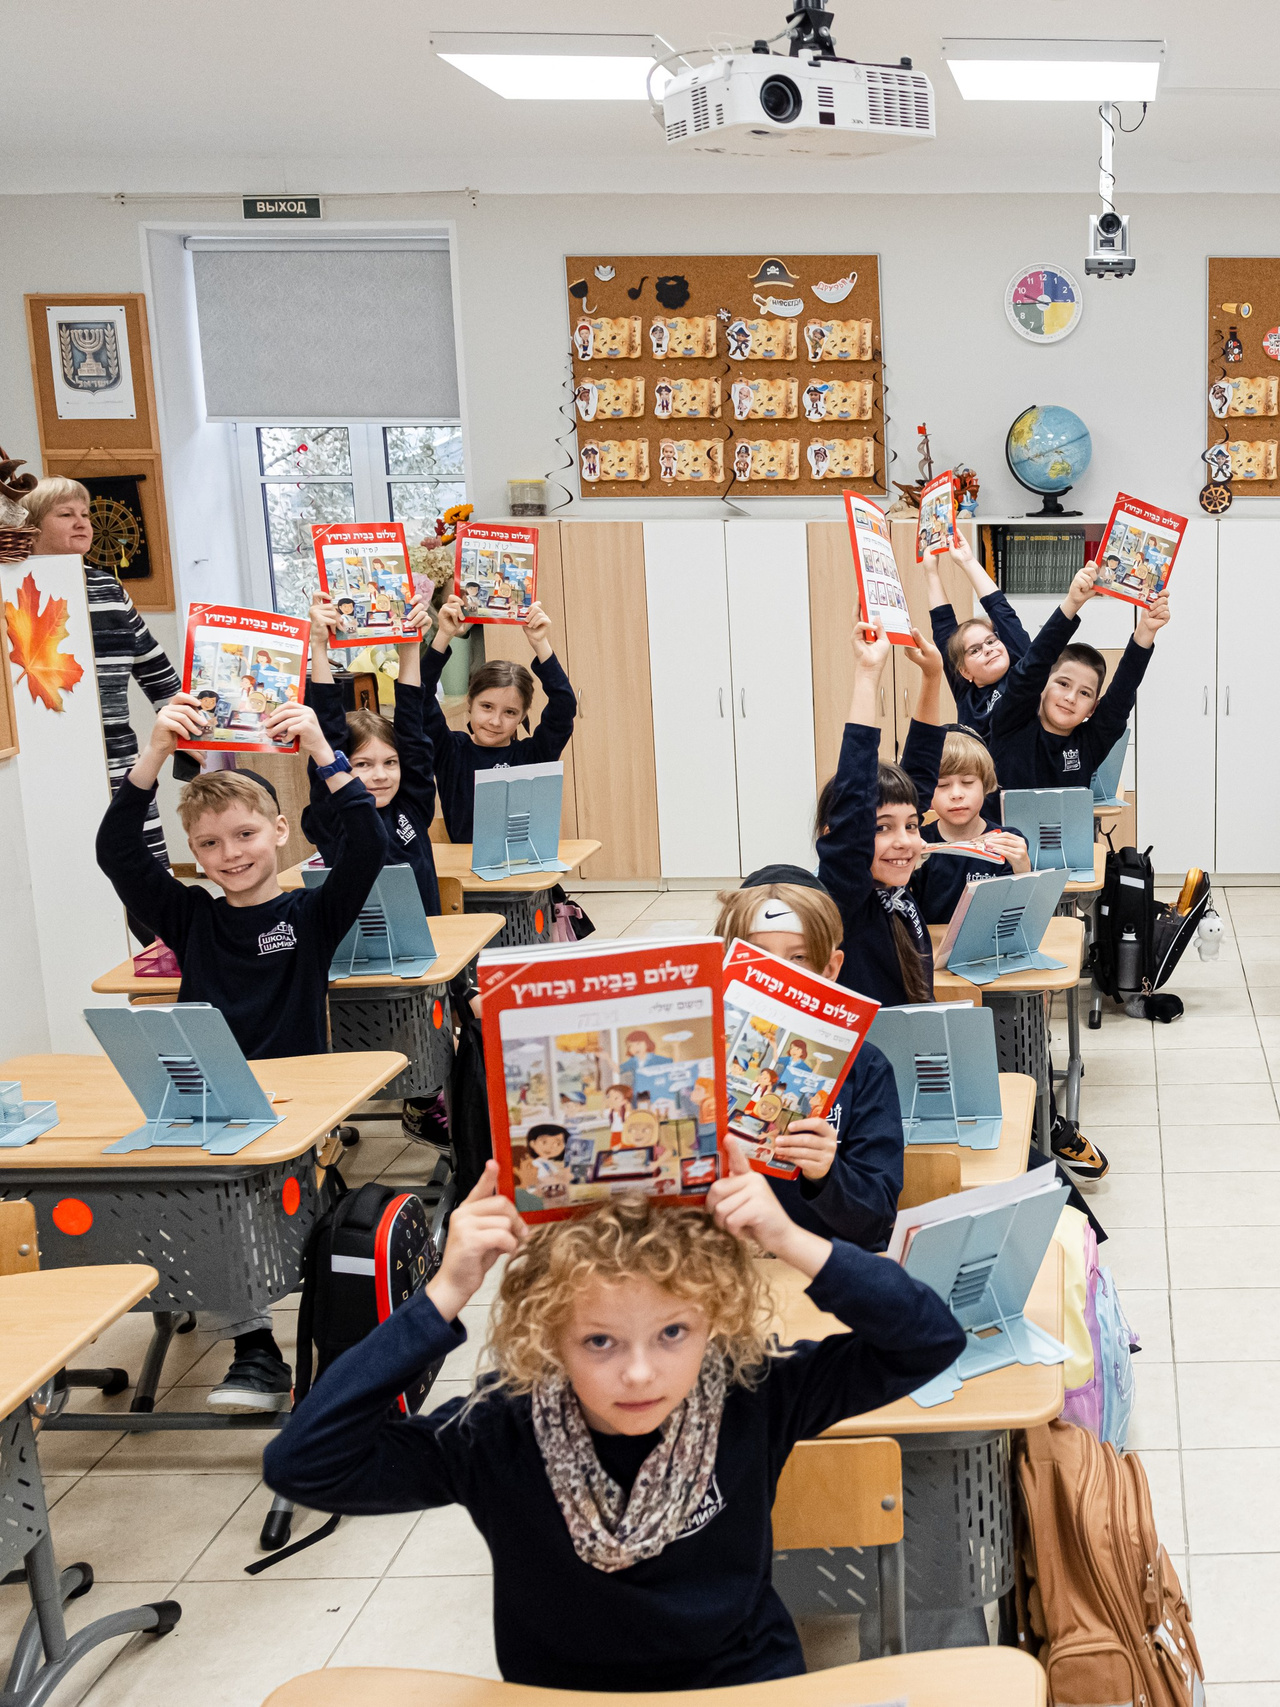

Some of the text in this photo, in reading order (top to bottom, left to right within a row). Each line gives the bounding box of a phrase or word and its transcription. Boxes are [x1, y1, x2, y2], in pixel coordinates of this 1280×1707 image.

[256, 202, 307, 214] ВЫХОД
[262, 935, 291, 944] ШКОЛА
[264, 941, 294, 951] ШАМИР
[684, 1505, 717, 1530] АМИР
